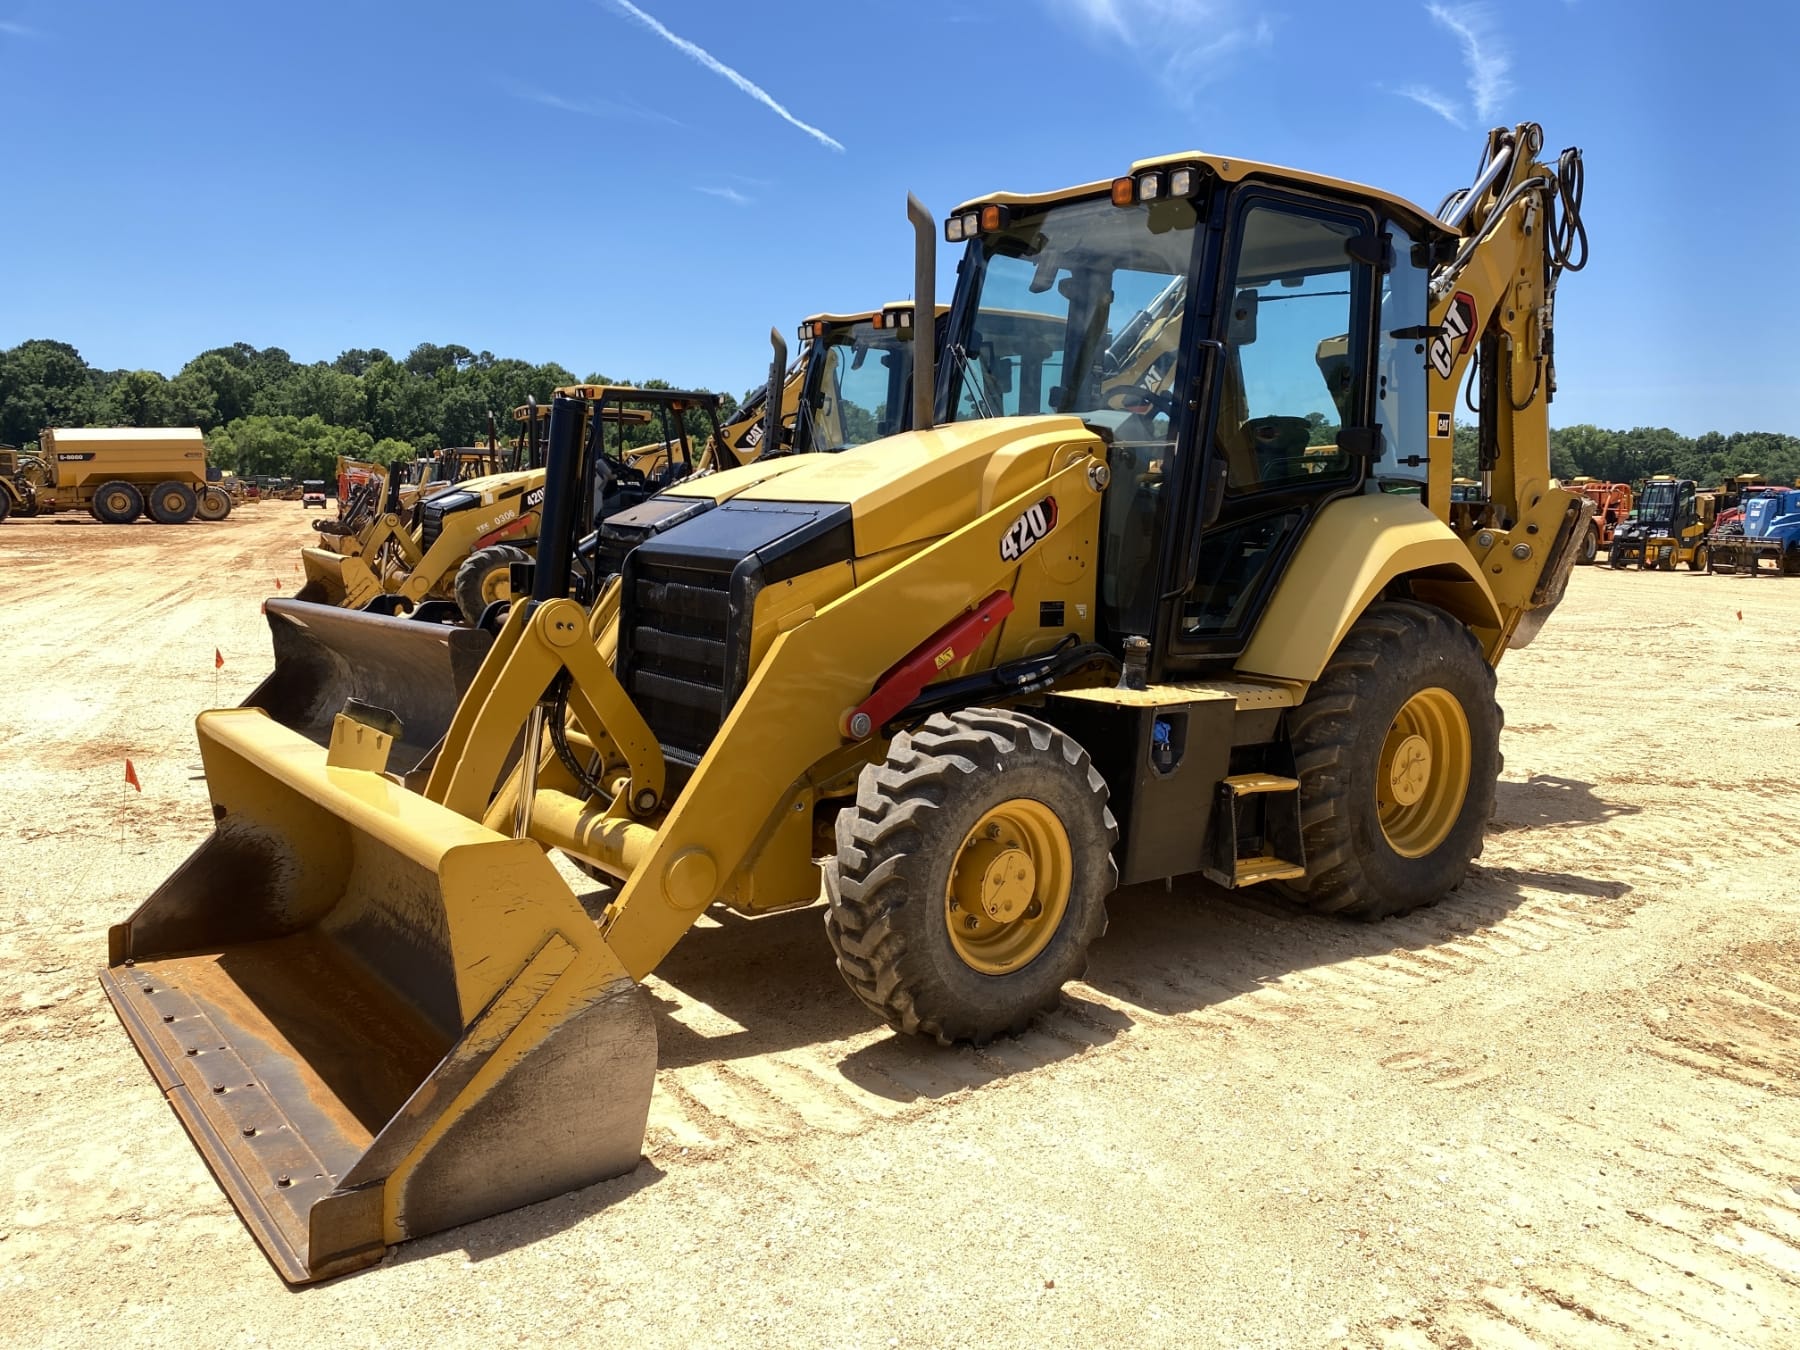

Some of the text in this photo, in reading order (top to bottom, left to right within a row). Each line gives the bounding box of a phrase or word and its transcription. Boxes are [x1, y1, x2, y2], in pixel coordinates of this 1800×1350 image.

[1430, 299, 1468, 378] CAT
[1139, 364, 1162, 391] AT
[745, 423, 763, 446] CAT
[1438, 419, 1449, 431] CAT
[527, 487, 545, 506] 420
[494, 509, 515, 525] 0306
[1001, 503, 1047, 559] 420
